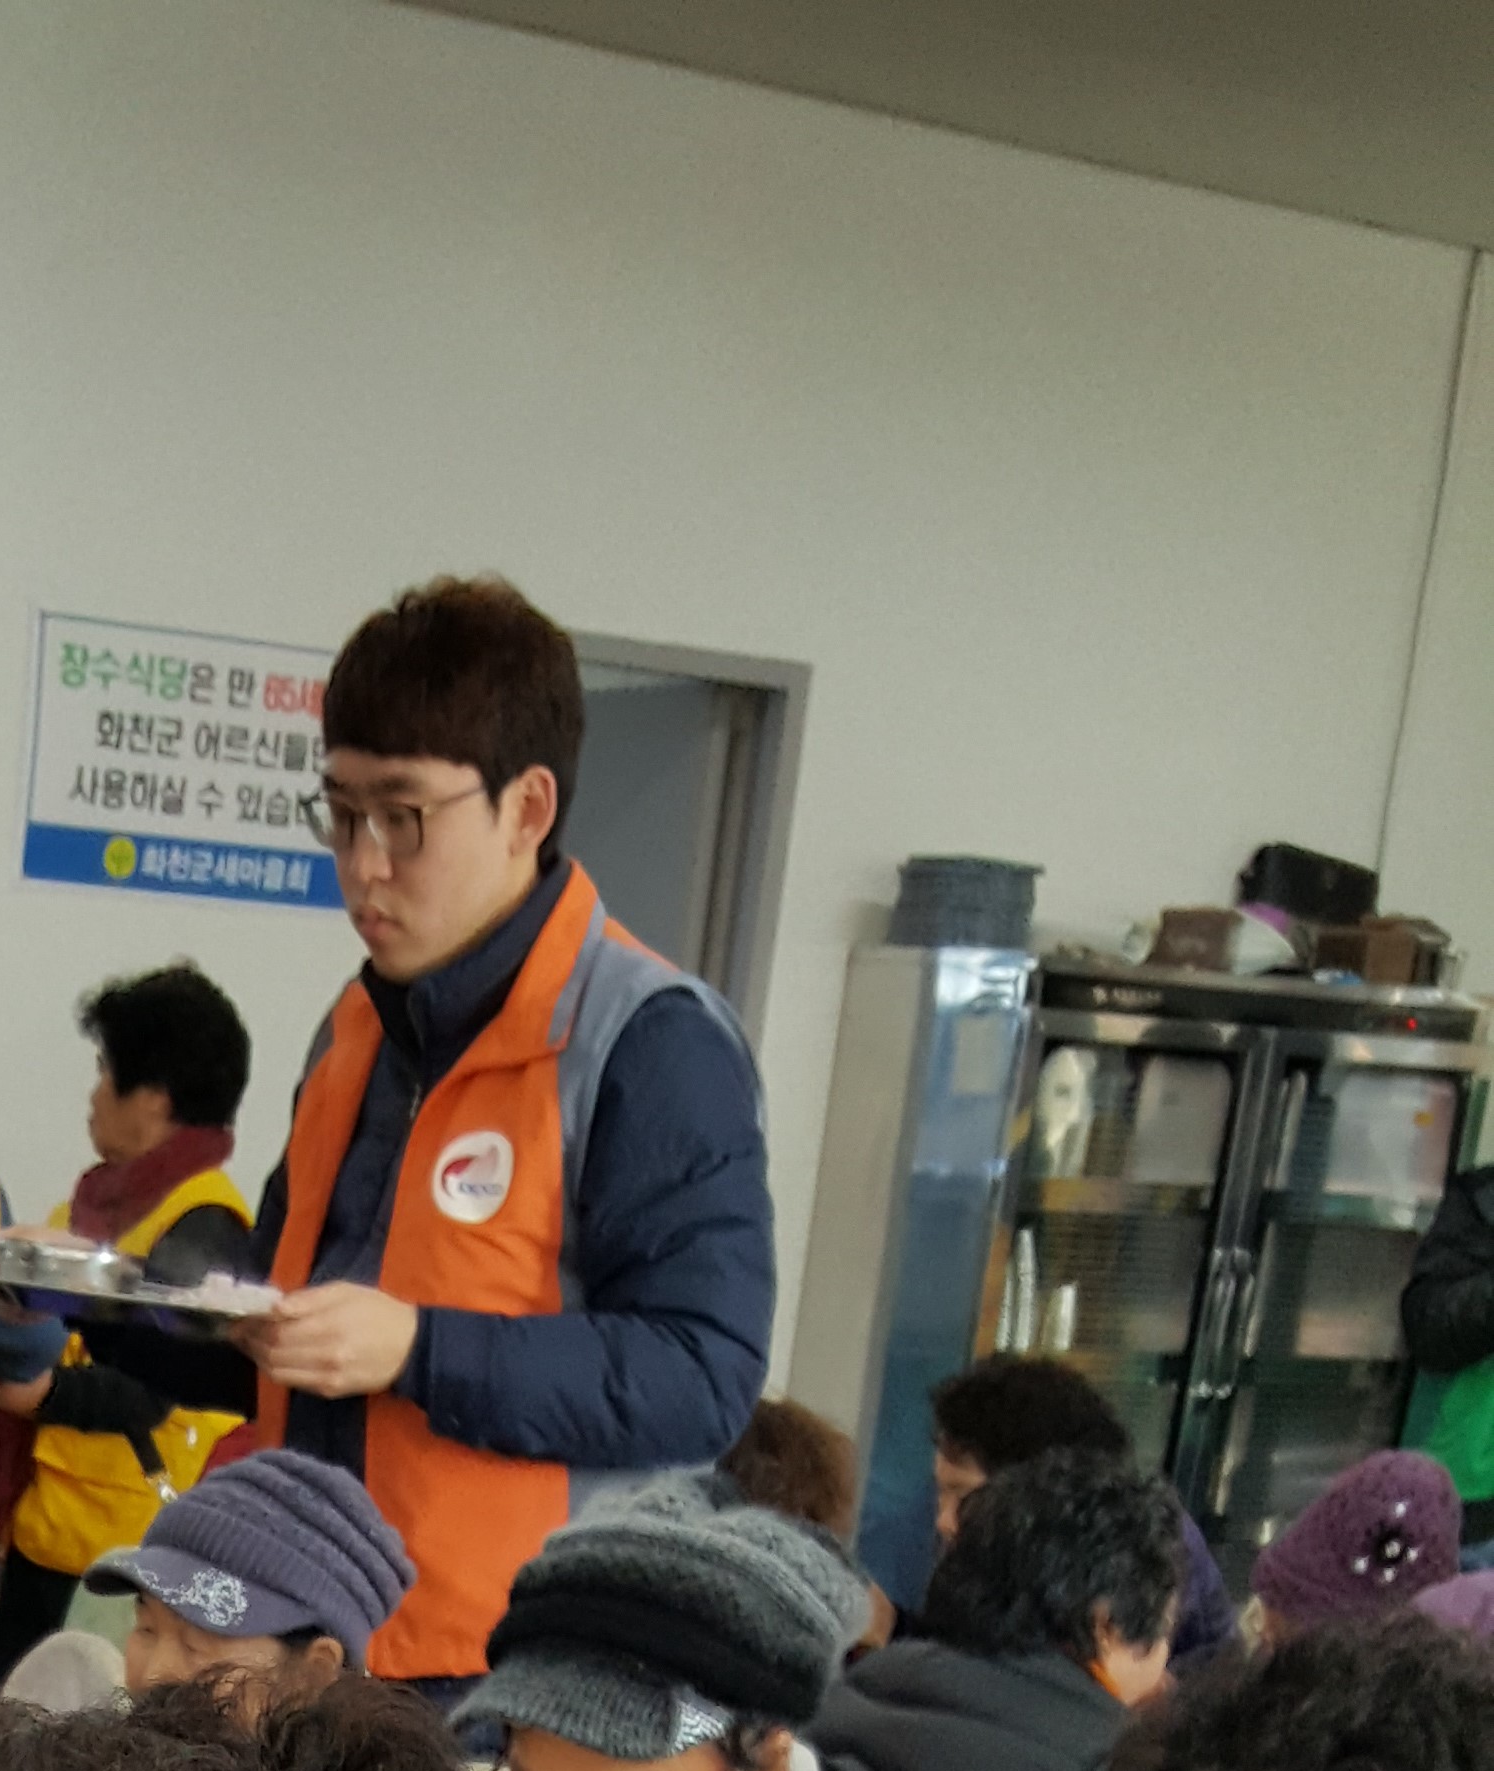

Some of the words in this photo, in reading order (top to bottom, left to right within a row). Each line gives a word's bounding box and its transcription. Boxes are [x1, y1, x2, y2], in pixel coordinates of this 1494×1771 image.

[59, 641, 215, 705] 장수식당은
[227, 666, 256, 709] 만
[95, 709, 184, 758] 화천군
[69, 764, 188, 817] 사용하실
[196, 779, 224, 820] 수
